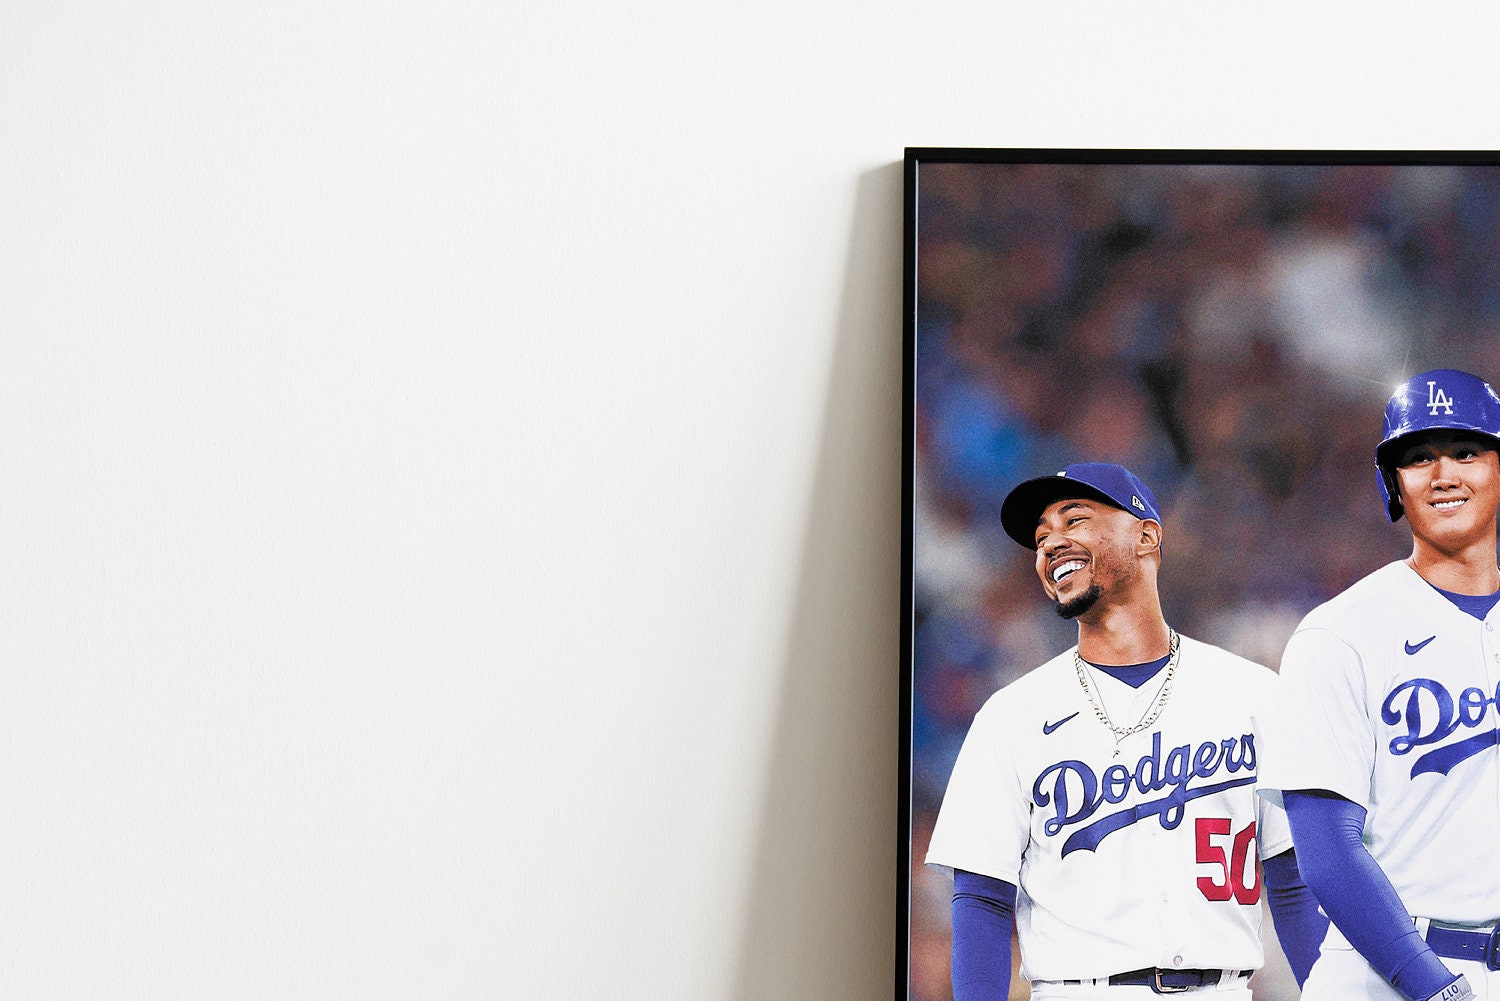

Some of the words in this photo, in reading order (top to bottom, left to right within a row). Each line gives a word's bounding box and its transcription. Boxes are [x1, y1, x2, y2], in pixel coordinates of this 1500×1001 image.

[1426, 381, 1454, 416] LA
[1032, 731, 1258, 837] Dodgers
[1195, 817, 1261, 906] 50
